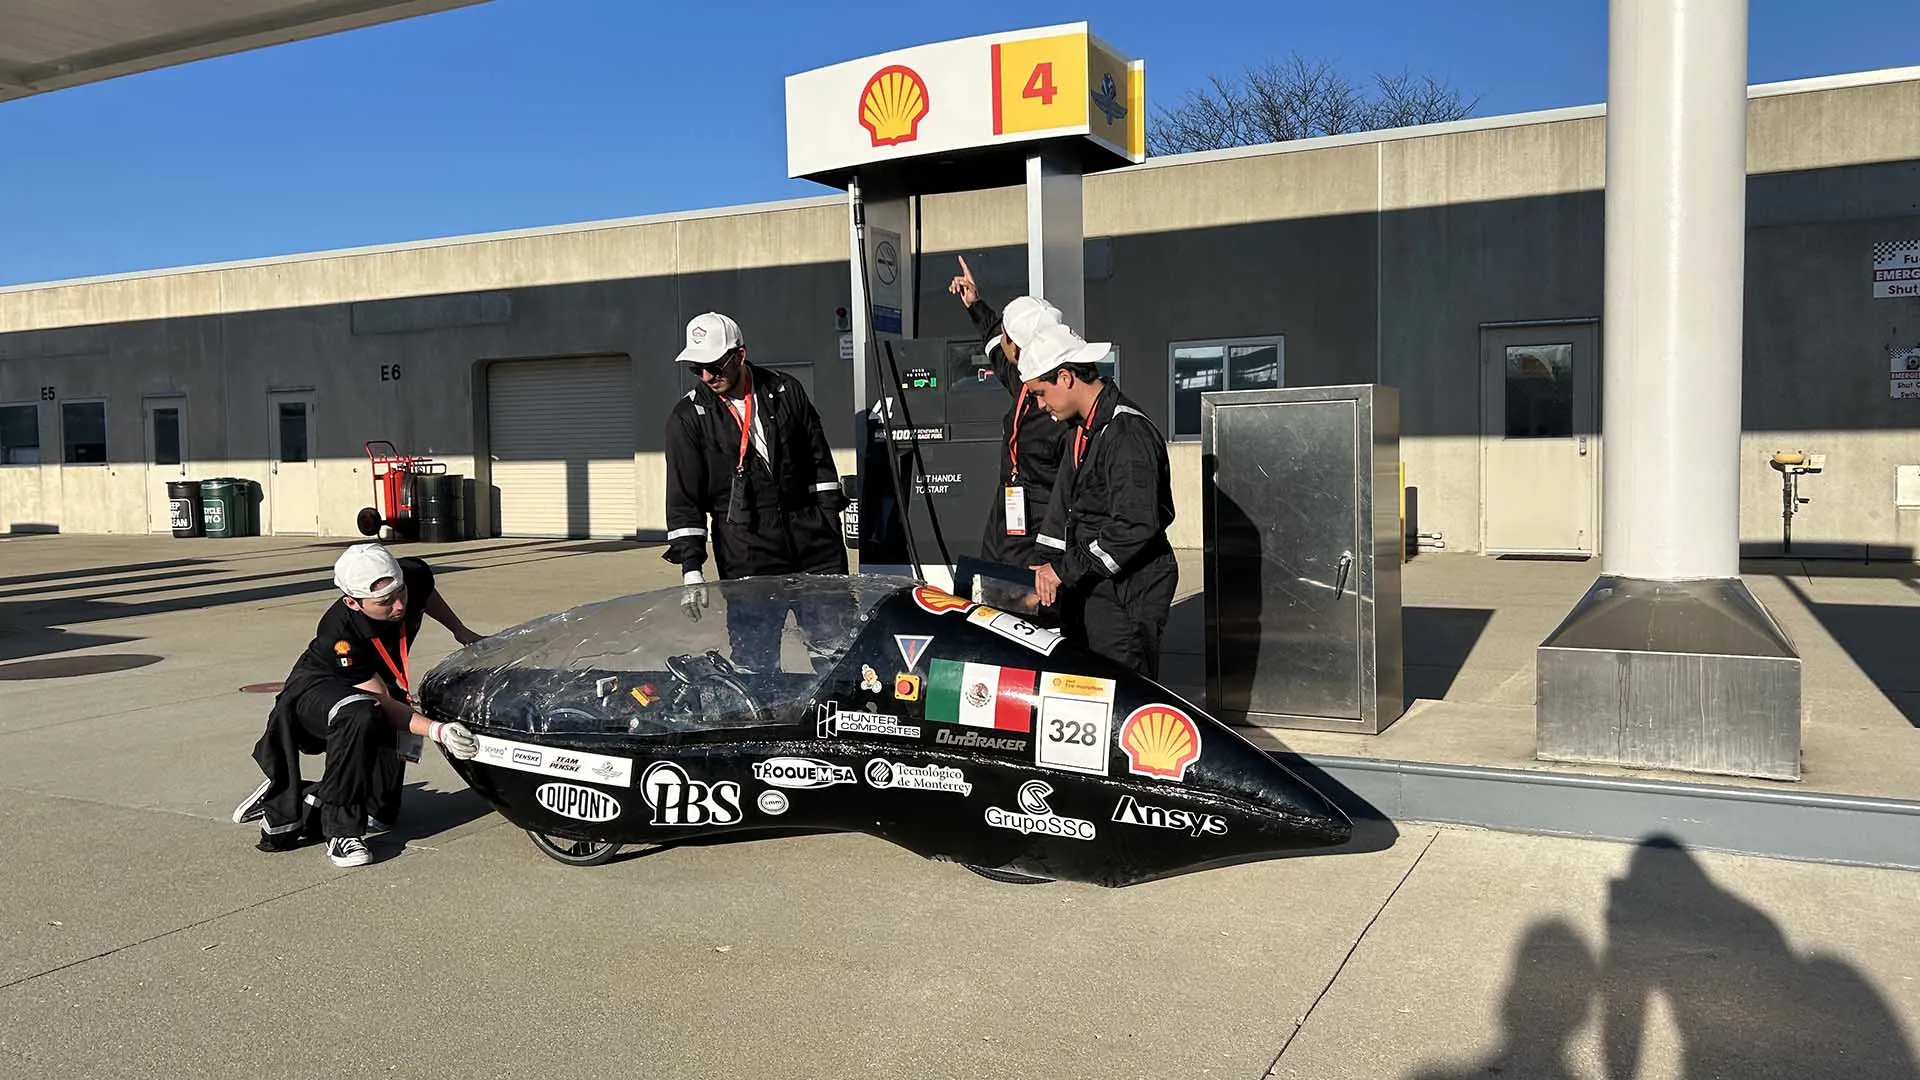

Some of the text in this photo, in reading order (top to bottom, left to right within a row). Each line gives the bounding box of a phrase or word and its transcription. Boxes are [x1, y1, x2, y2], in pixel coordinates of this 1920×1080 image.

[1022, 62, 1058, 105] 4
[381, 363, 401, 381] E6
[41, 386, 55, 401] E5
[931, 473, 962, 483] HANDLE
[841, 712, 897, 725] HUNTER
[840, 722, 920, 736] COMPOSITES
[1048, 718, 1097, 746] 328
[549, 762, 581, 772] PENSKE
[556, 756, 579, 764] TEAM
[897, 764, 962, 780] Tecnológico
[897, 777, 971, 795] de Monterrey
[546, 785, 610, 819] DUPONT
[987, 808, 1093, 839] GrupoSSC
[1113, 796, 1227, 837] Ansys
